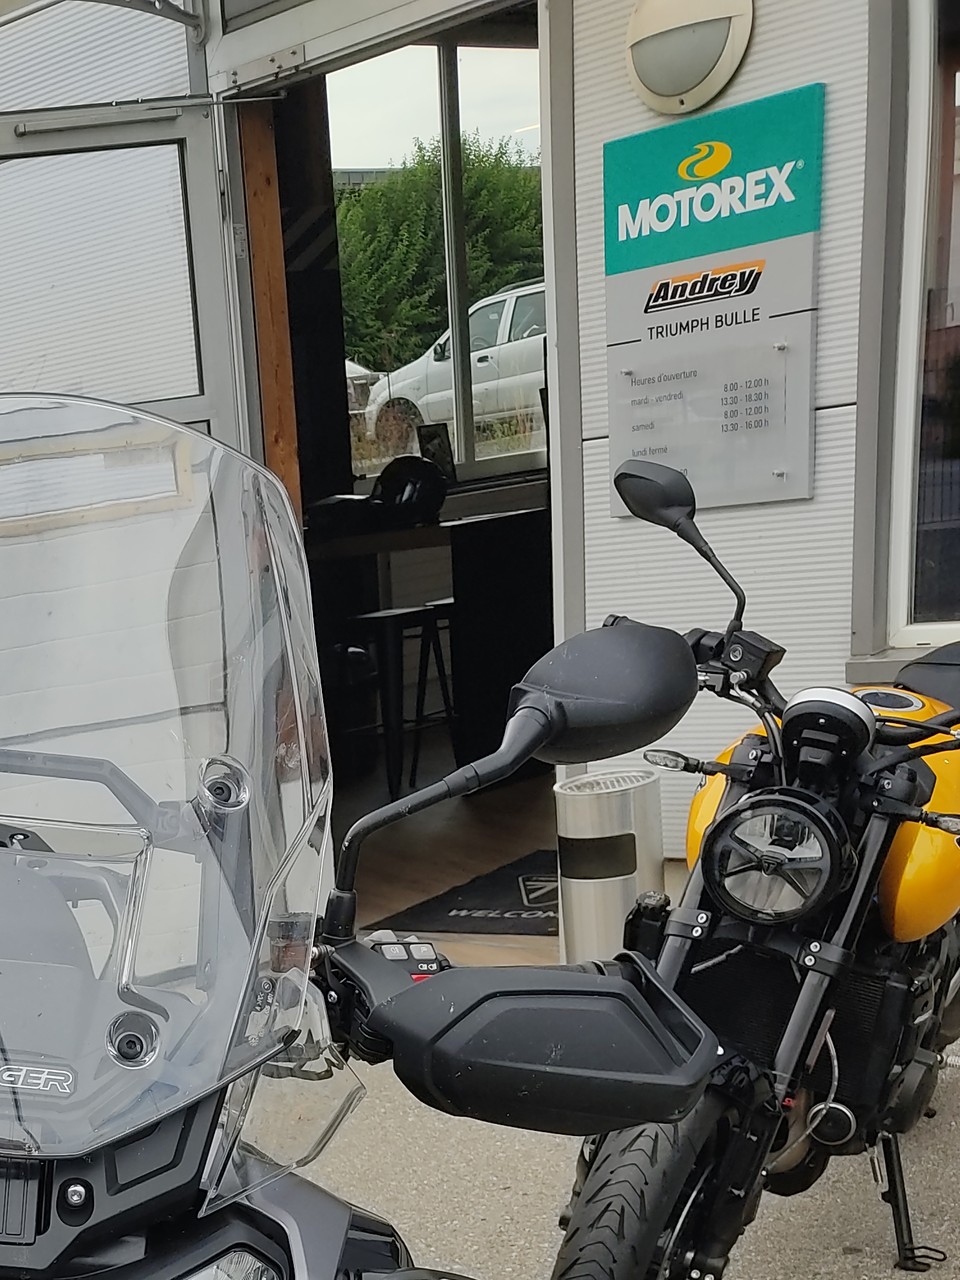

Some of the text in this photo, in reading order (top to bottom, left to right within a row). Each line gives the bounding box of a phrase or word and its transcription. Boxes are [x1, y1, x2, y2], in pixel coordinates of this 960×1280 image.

[618, 161, 796, 241] MOTOREX
[651, 267, 758, 305] Andrey
[647, 307, 760, 340] TRIUMPH BULLE
[631, 369, 698, 387] Heures d'ouverture
[745, 378, 763, 389] 12.00
[764, 378, 769, 386] h
[631, 395, 650, 406] mardi
[655, 391, 684, 403] vendredi
[721, 395, 738, 406] 13.30
[745, 392, 763, 402] 18.30
[764, 391, 769, 400] h
[745, 406, 763, 416] 12.00
[764, 405, 769, 413] h
[632, 421, 655, 432] samedi
[721, 423, 739, 433] 13.30
[745, 419, 763, 429] 16.00
[764, 418, 769, 427] h
[632, 445, 668, 457] lundi fermé
[448, 909, 559, 918] WELCOM
